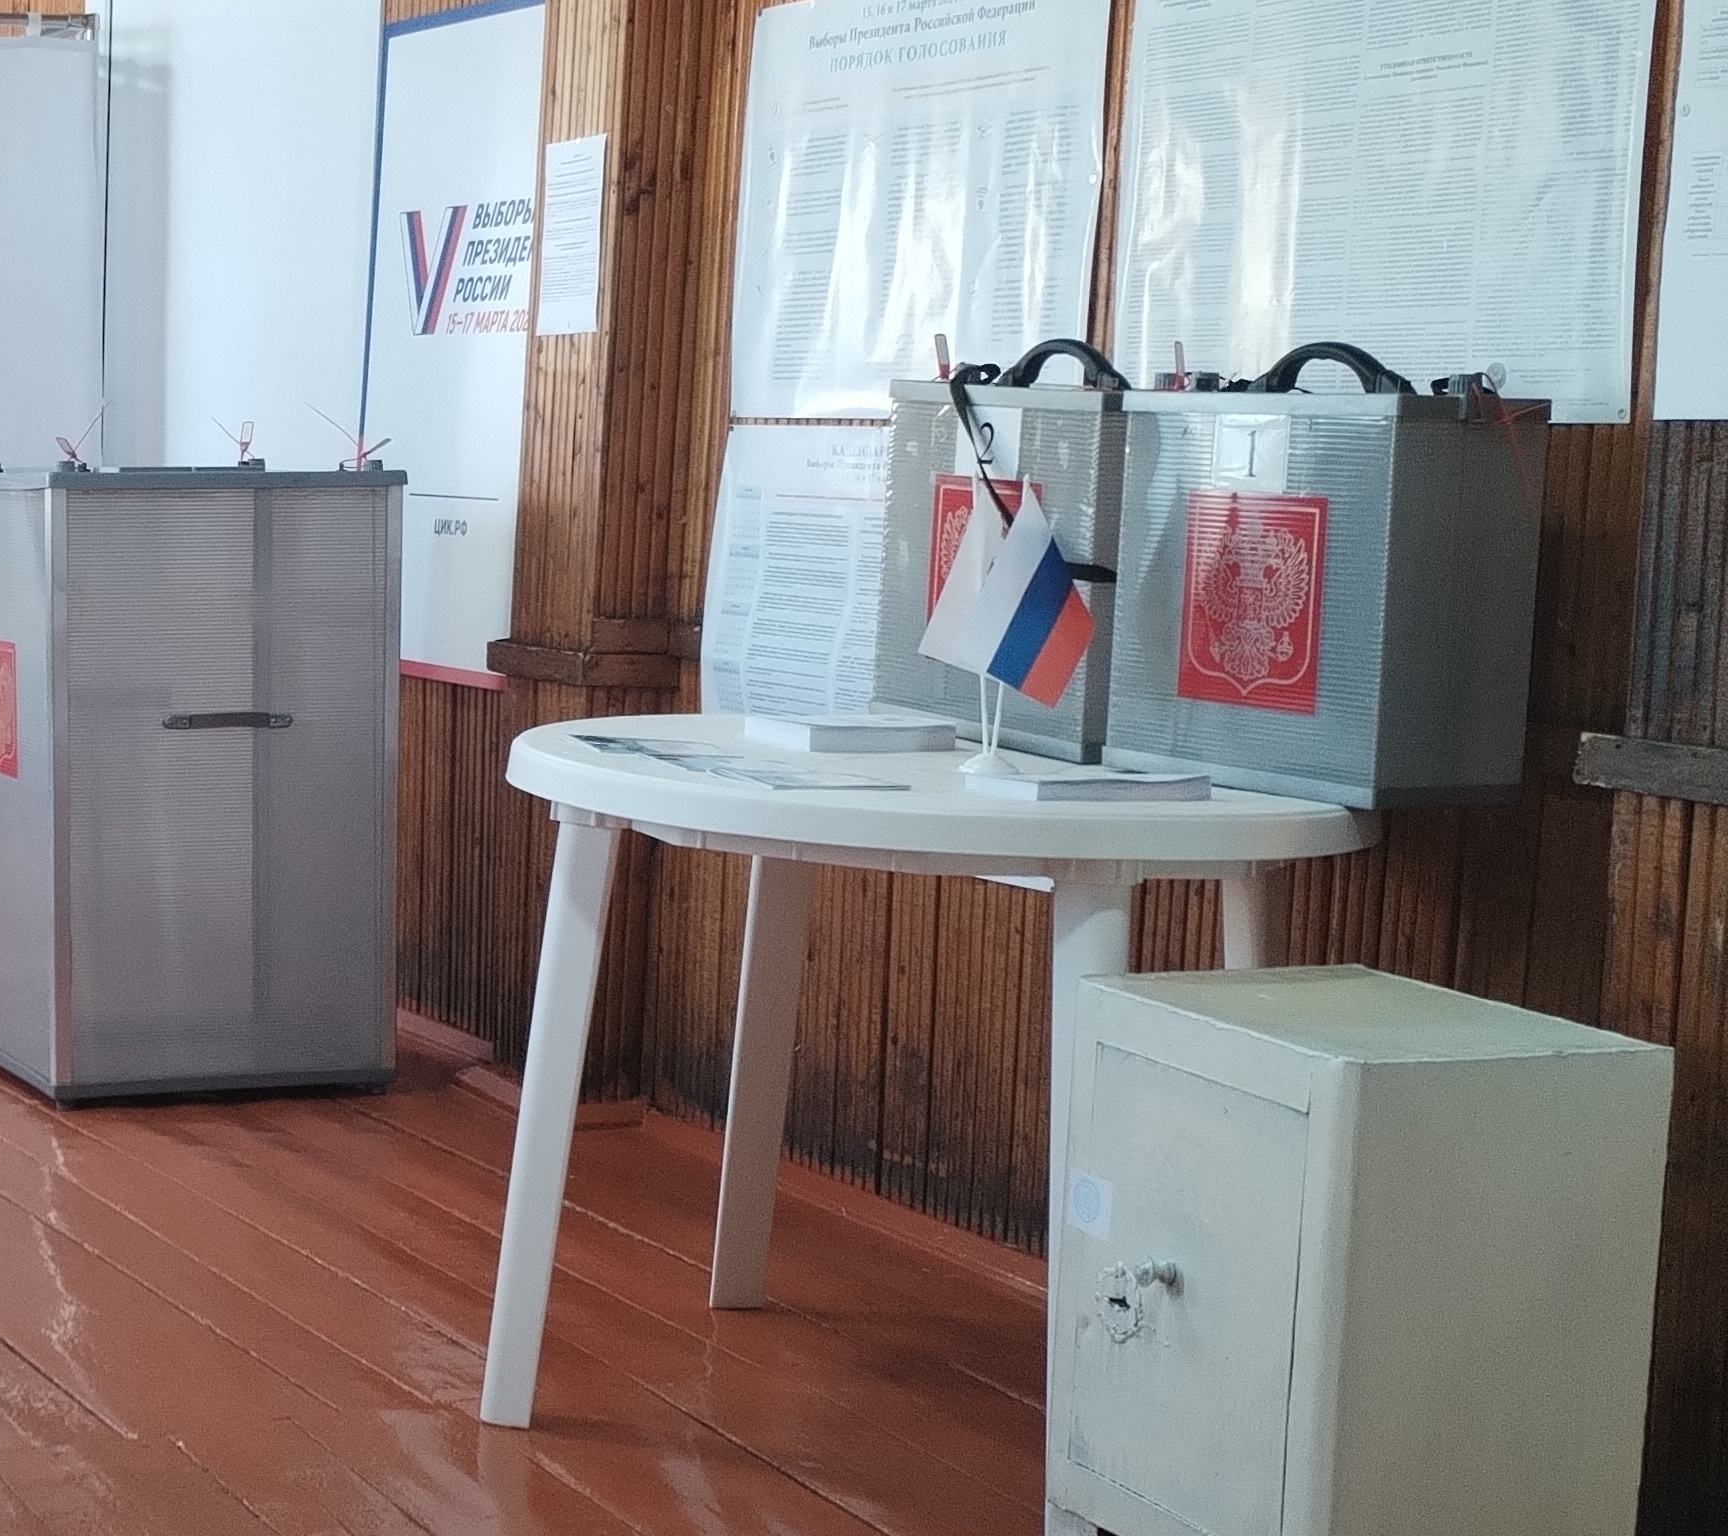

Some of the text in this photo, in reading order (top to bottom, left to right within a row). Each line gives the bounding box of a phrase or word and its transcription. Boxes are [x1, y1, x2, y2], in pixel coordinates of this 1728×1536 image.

[809, 0, 1036, 50] Выборы Президента Российской Федерации
[877, 4, 886, 16] 16
[897, 0, 906, 13] 17
[908, 0, 936, 13] марта
[829, 30, 1006, 73] ПОРЯДОК ГОЛОСОВАНИЯ
[452, 274, 513, 303] РОССИИ
[473, 311, 509, 333] МАРТА
[977, 422, 995, 464] 2
[1244, 430, 1257, 477] 1
[434, 518, 467, 537] ЦИК.РФ
